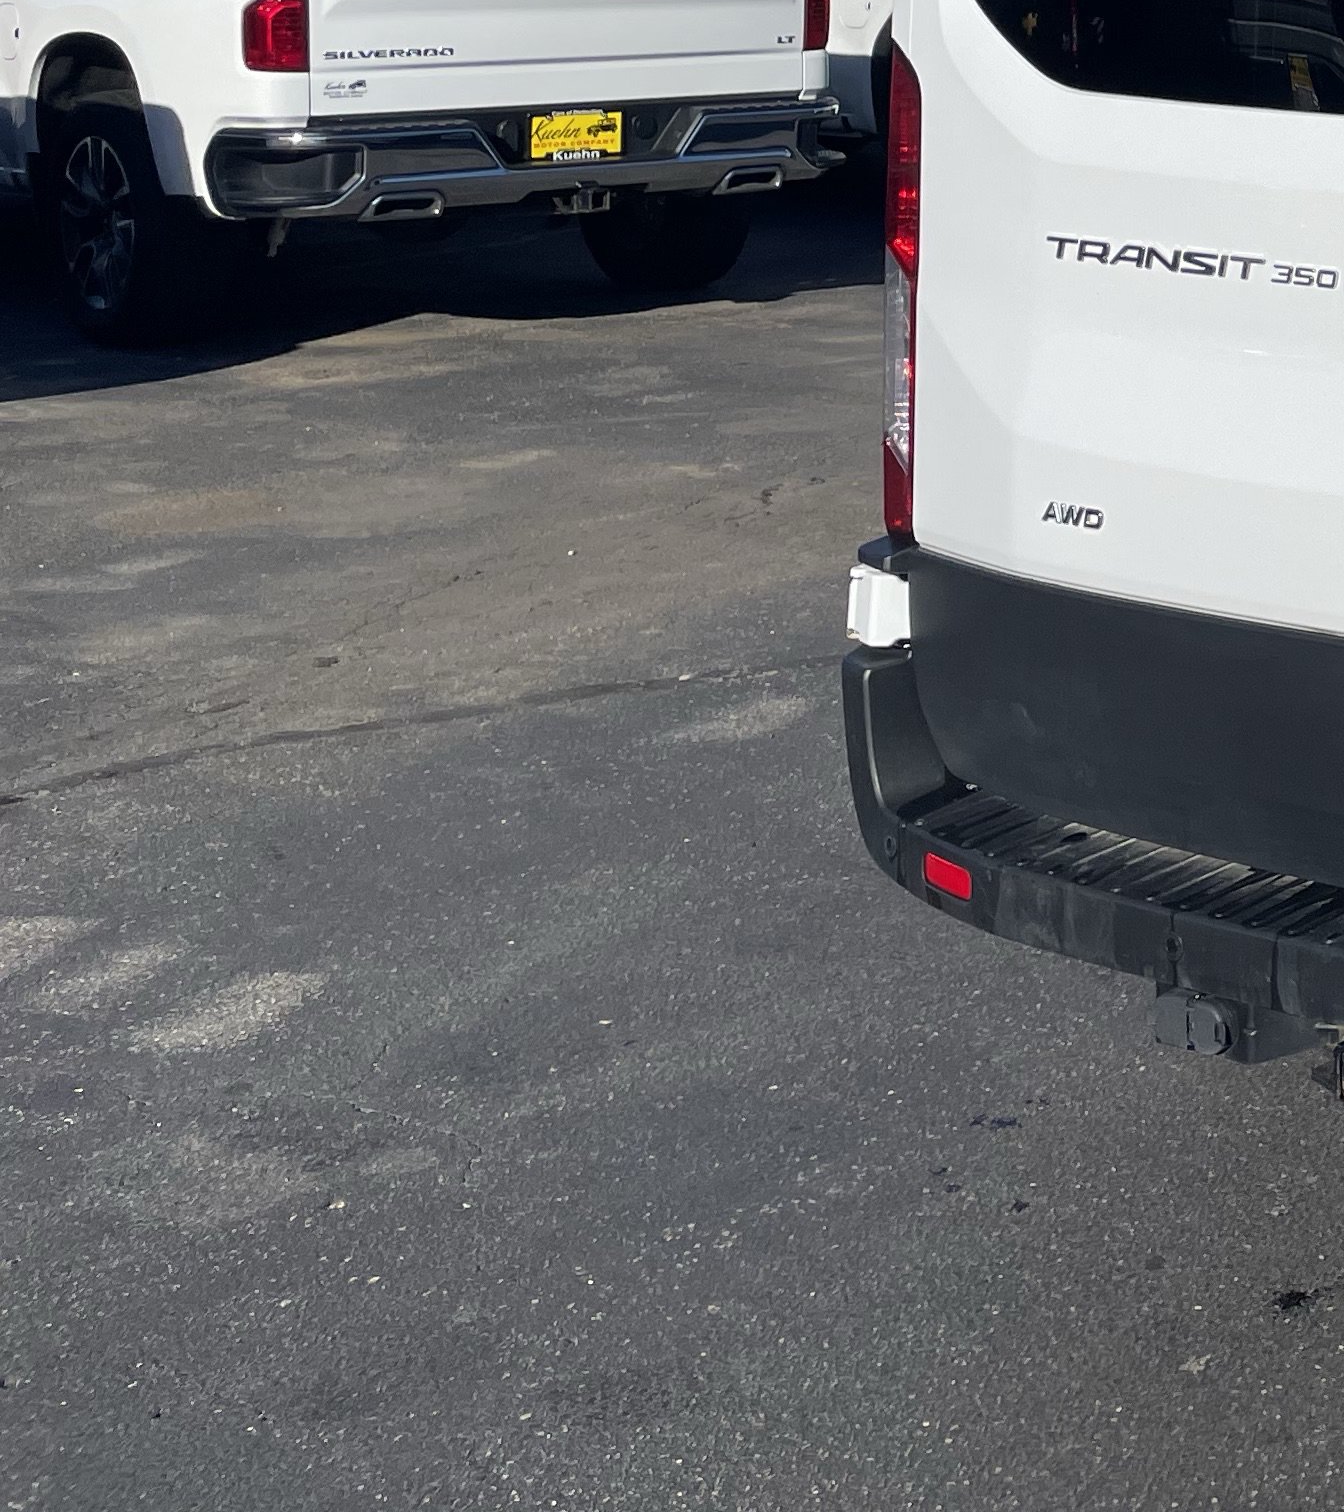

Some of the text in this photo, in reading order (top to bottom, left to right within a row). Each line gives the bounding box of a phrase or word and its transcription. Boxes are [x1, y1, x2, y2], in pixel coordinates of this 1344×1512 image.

[777, 35, 796, 44] LT
[323, 47, 455, 60] SILVERADO
[531, 117, 581, 143] Kuehn
[533, 138, 615, 149] MOTOR COMPANY
[553, 150, 600, 161] Kuehn
[1046, 235, 1340, 289] TRANSIT 350
[1042, 501, 1104, 530] AWD
